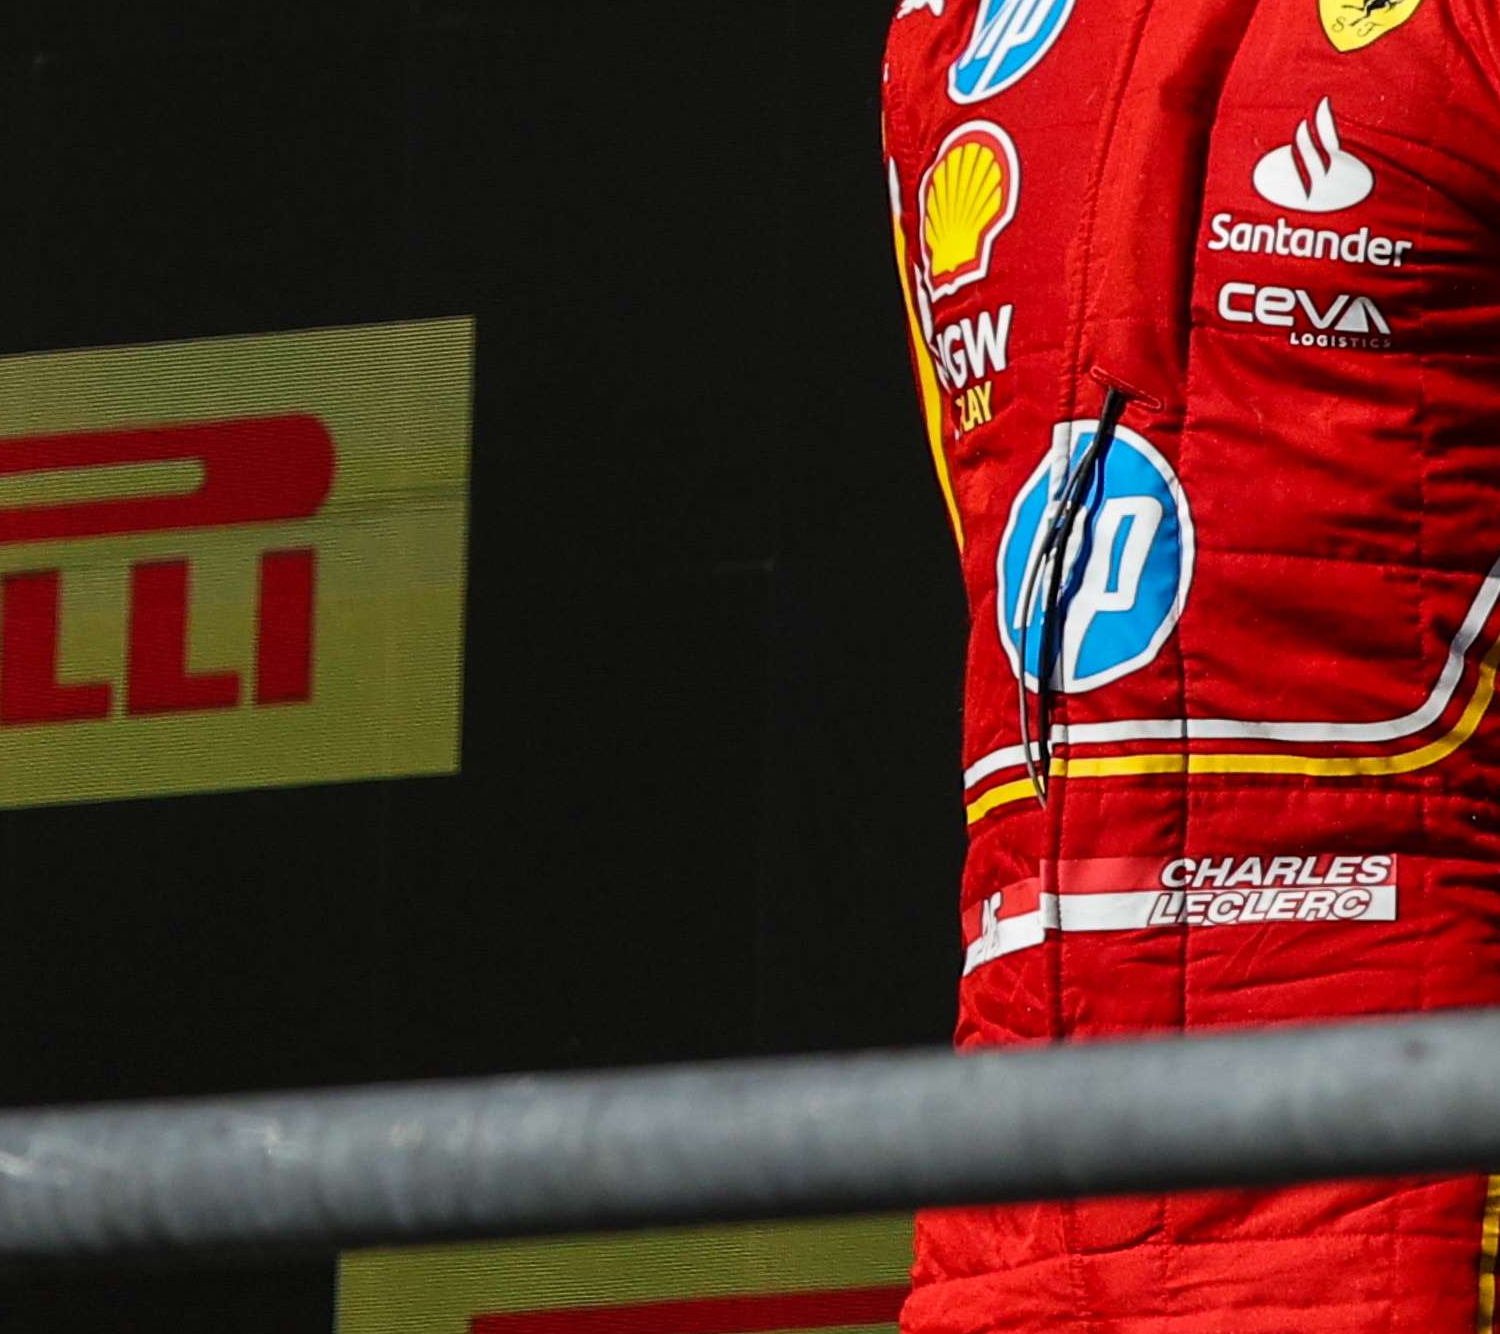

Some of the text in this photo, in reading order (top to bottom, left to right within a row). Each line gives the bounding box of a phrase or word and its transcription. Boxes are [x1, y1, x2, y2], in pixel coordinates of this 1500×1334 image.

[1207, 212, 1413, 267] Santander
[1289, 331, 1392, 348] LOGISTICS
[1161, 855, 1394, 889] CHARLES
[1148, 887, 1372, 927] LECLERC
